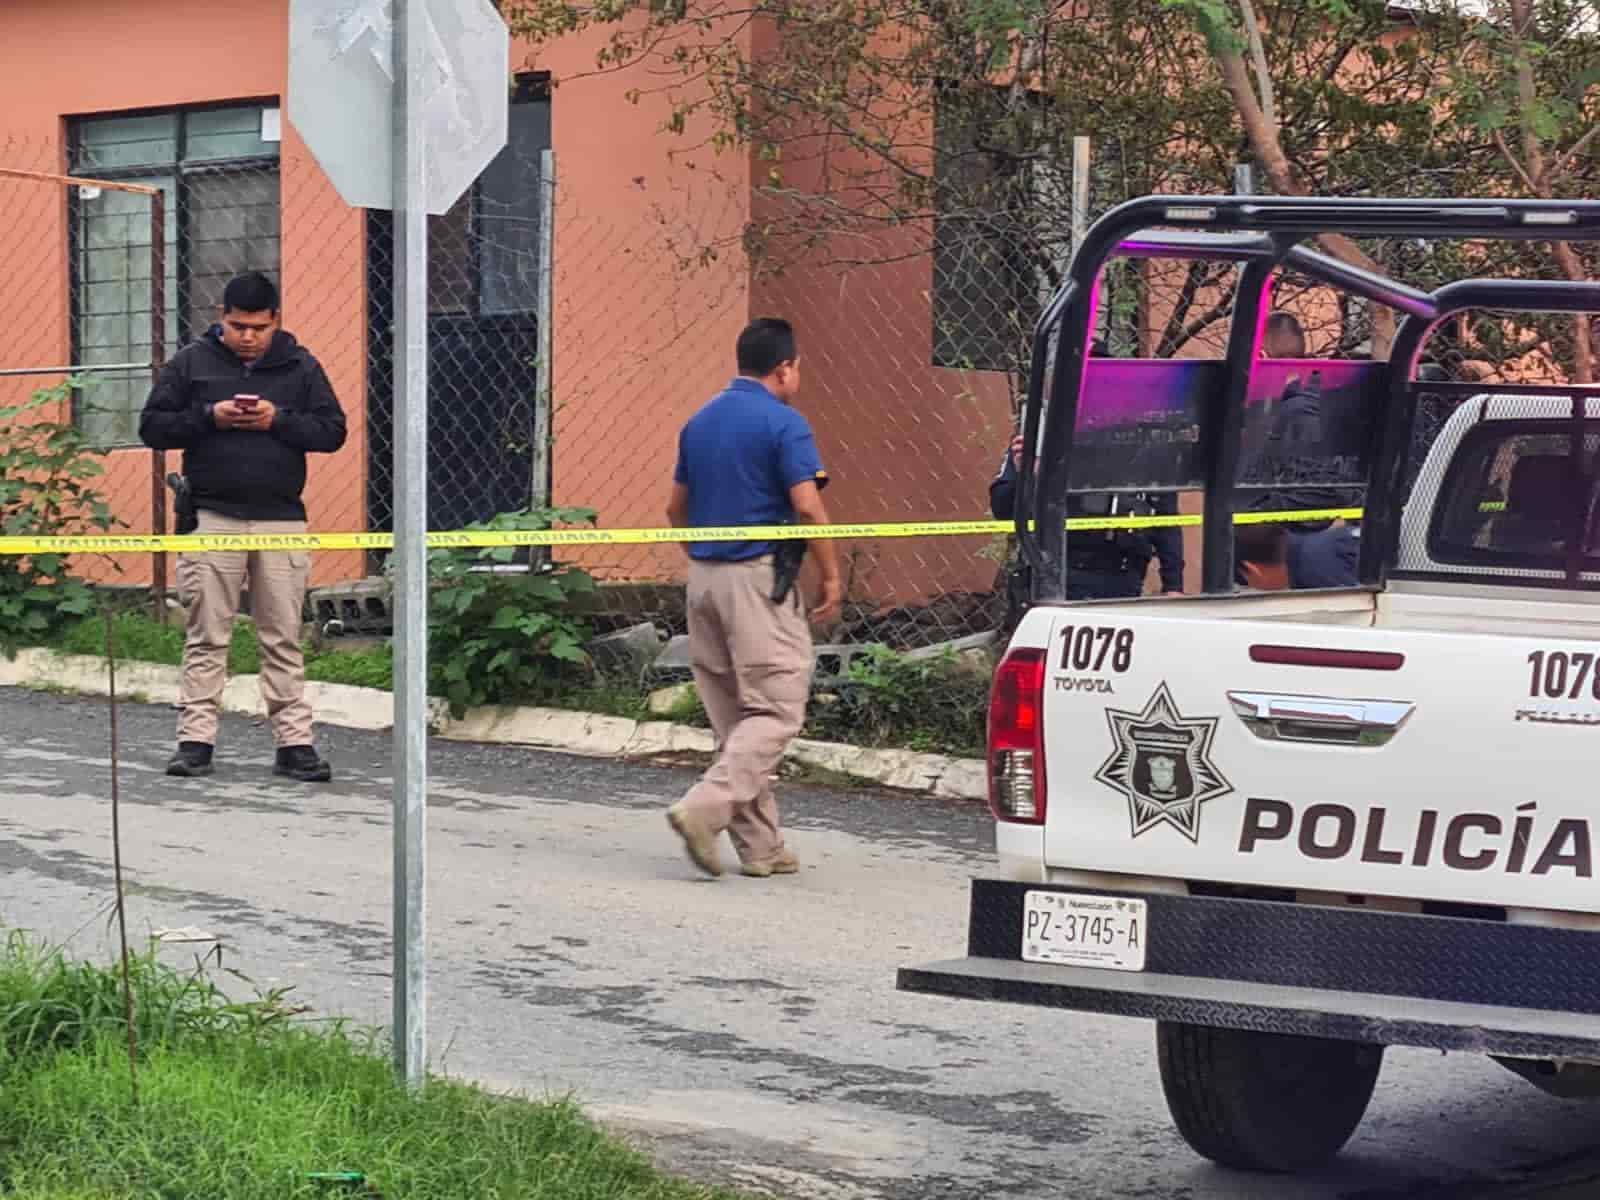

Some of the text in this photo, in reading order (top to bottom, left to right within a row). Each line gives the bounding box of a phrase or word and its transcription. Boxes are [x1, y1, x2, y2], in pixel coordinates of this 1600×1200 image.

[1060, 625, 1135, 673] 1078
[1054, 677, 1115, 695] TOYOTA
[1238, 798, 1593, 878] POLICÍA
[1027, 910, 1139, 949] PZ-3745-A
